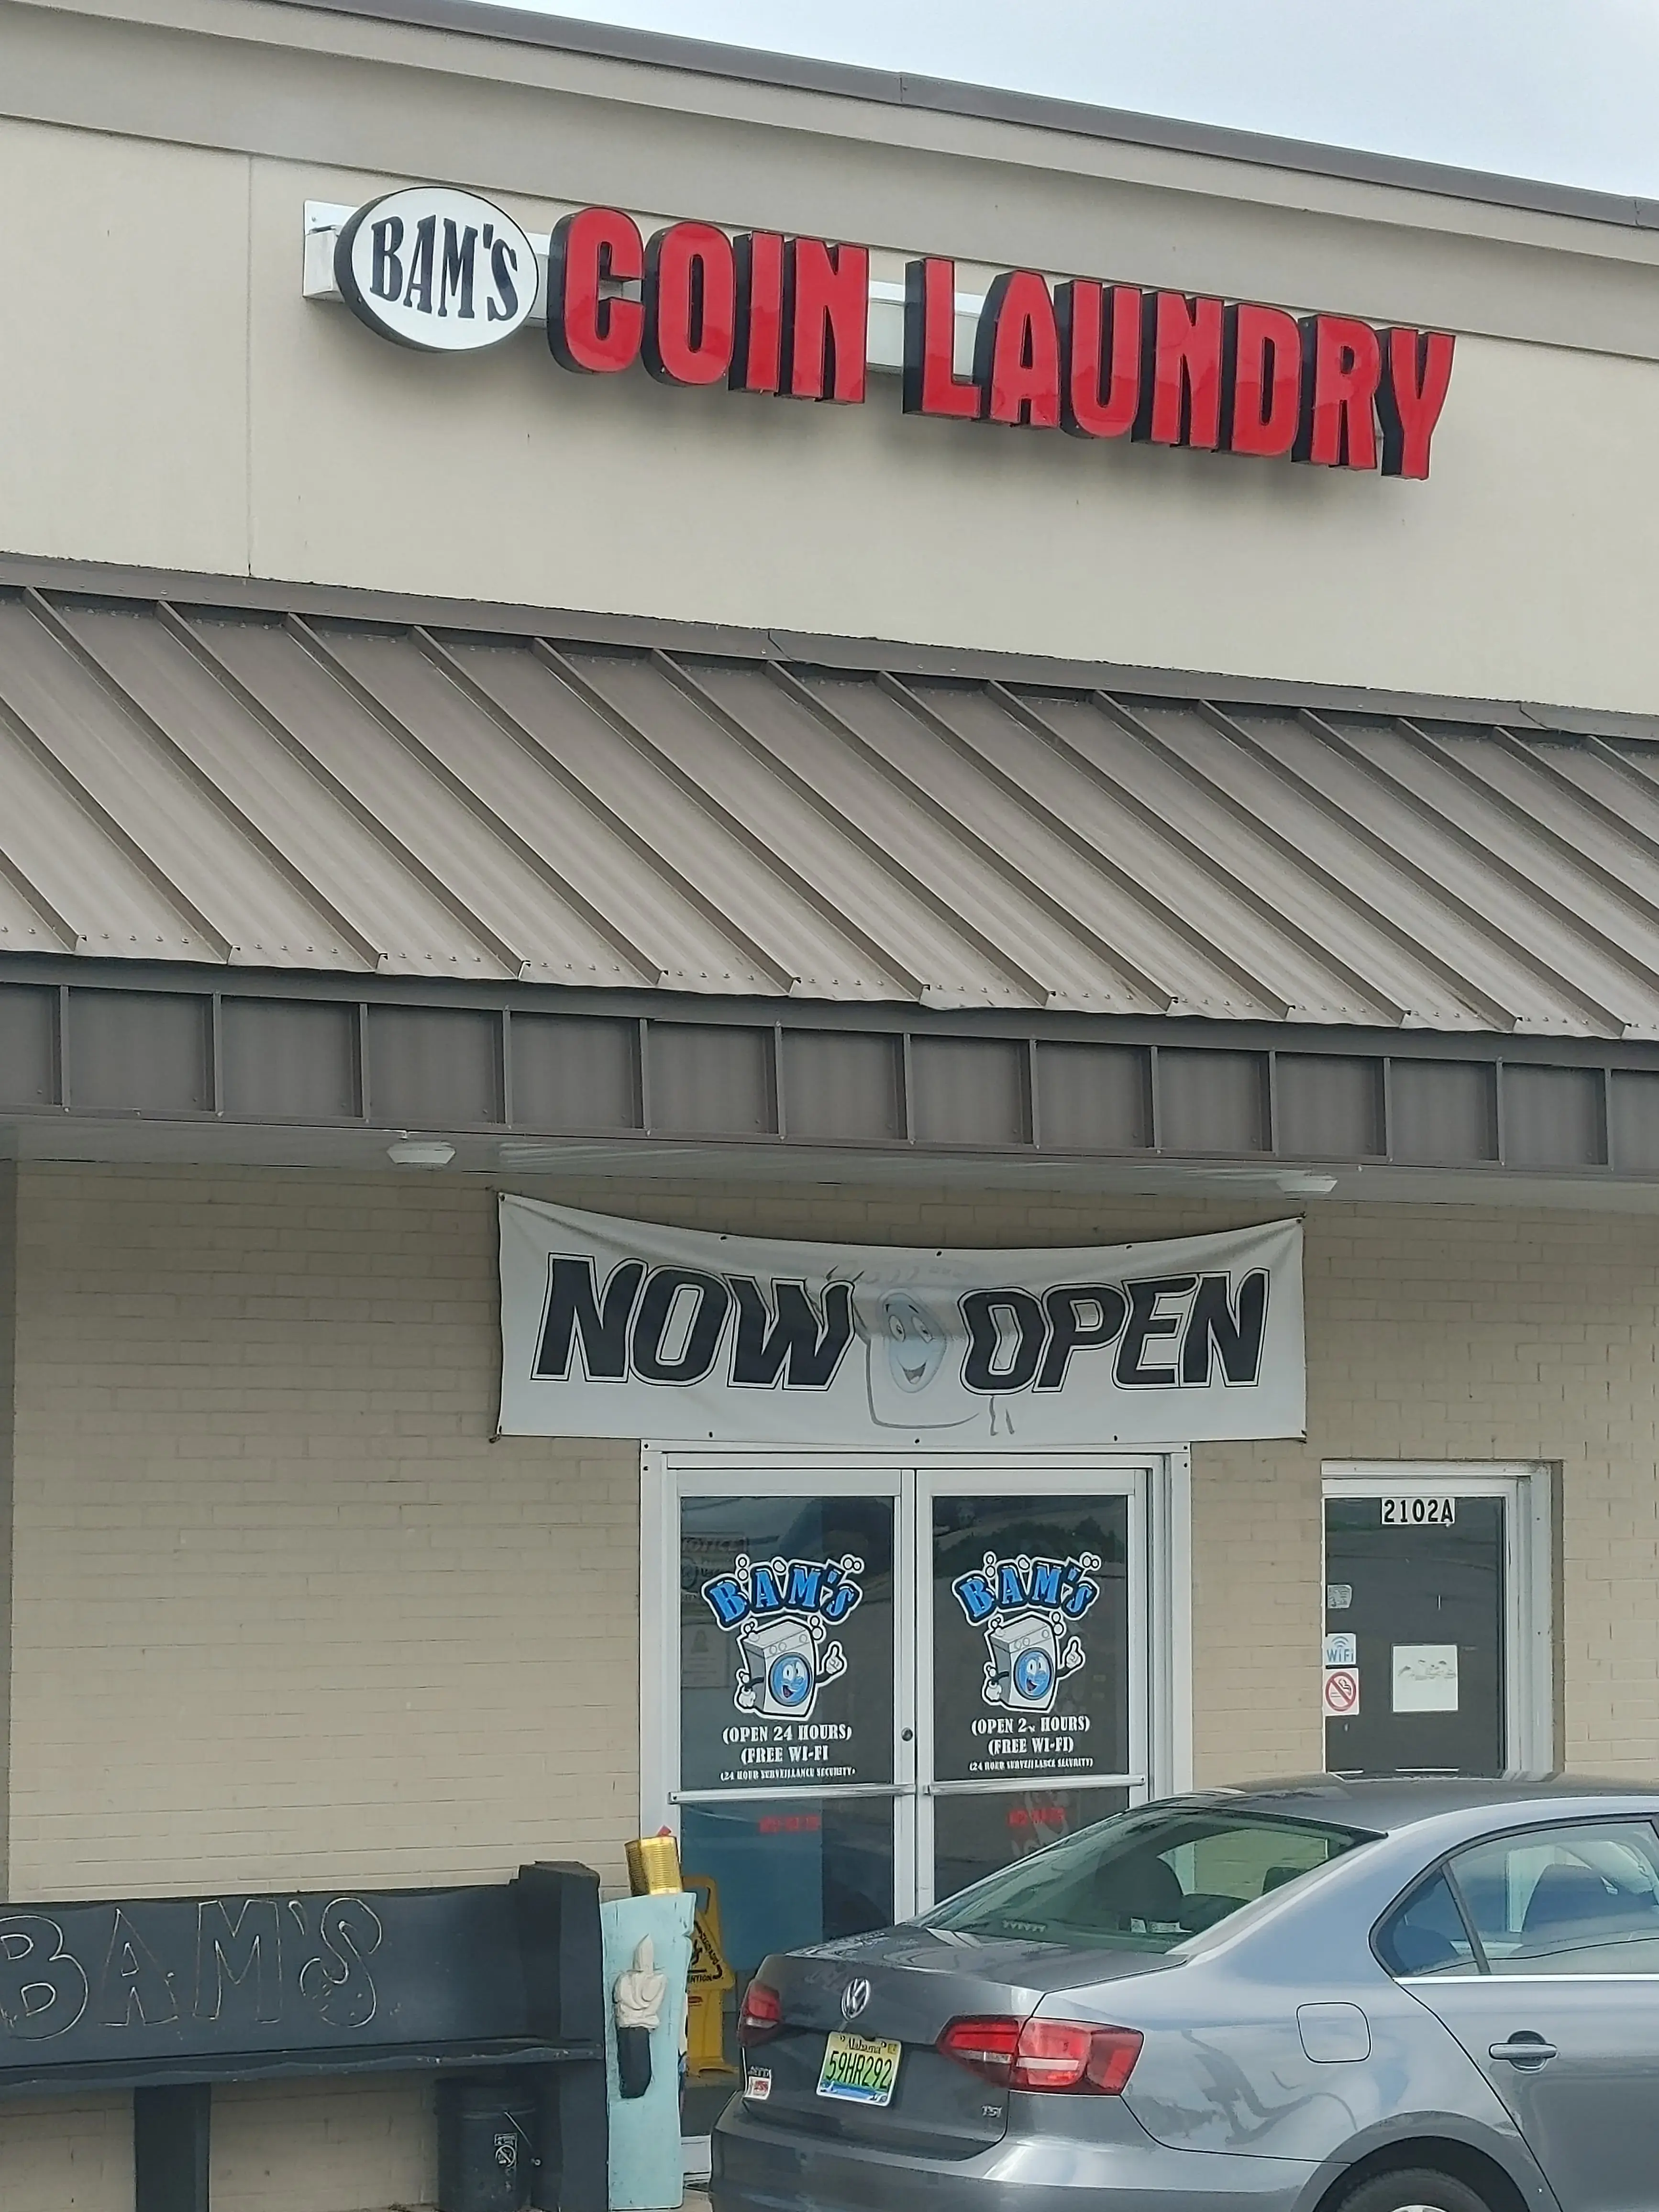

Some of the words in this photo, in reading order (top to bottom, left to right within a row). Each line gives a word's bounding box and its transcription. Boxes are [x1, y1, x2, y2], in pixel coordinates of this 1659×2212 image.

[370, 214, 519, 321] BAM'S
[547, 207, 869, 404] COIN
[902, 257, 1455, 480] LAUNDRY
[530, 1252, 855, 1392] NOW
[958, 1267, 1270, 1394] OPEN
[1384, 1499, 1453, 1522] 2102A
[701, 1558, 863, 1631] BAM'S
[952, 1556, 1099, 1626] BAM'S
[722, 1726, 768, 1745] (OPEN
[773, 1725, 793, 1741] 24
[798, 1724, 852, 1741] HOURS)
[741, 1747, 783, 1765] (FREE
[971, 1718, 1014, 1736] (OPEN
[1040, 1715, 1091, 1732] HOURS)
[988, 1738, 1028, 1756] (FREE
[1031, 1736, 1074, 1753] WI-FI)
[0, 1898, 382, 2041] BAM'S
